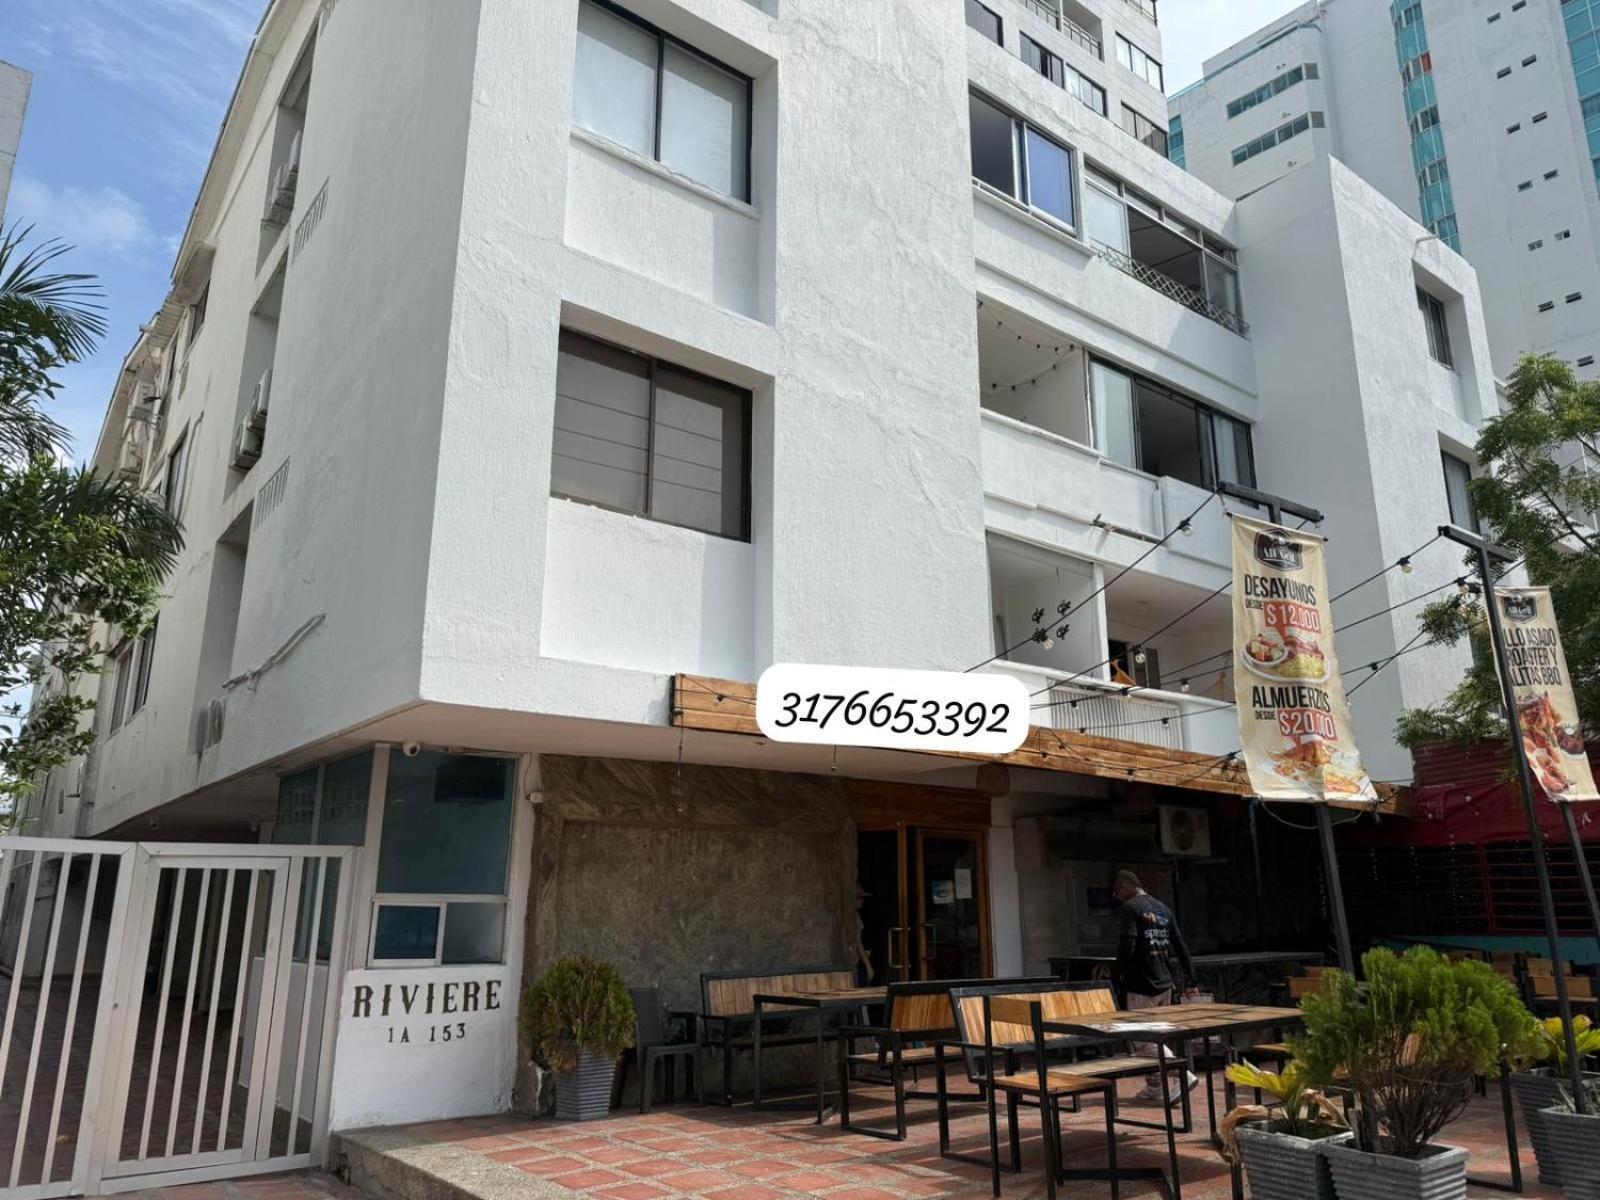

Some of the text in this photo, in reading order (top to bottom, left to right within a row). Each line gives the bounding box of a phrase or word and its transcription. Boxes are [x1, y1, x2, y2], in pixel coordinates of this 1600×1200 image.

[1244, 574, 1316, 606] DESAYUNOS
[1503, 627, 1557, 647] LLO ASADO
[1505, 647, 1558, 667] ROASTER Y
[1541, 666, 1562, 686] BBQ
[1255, 710, 1276, 721] DESDE
[352, 979, 502, 1018] RIVIERE
[388, 1022, 466, 1043] 1A 153
